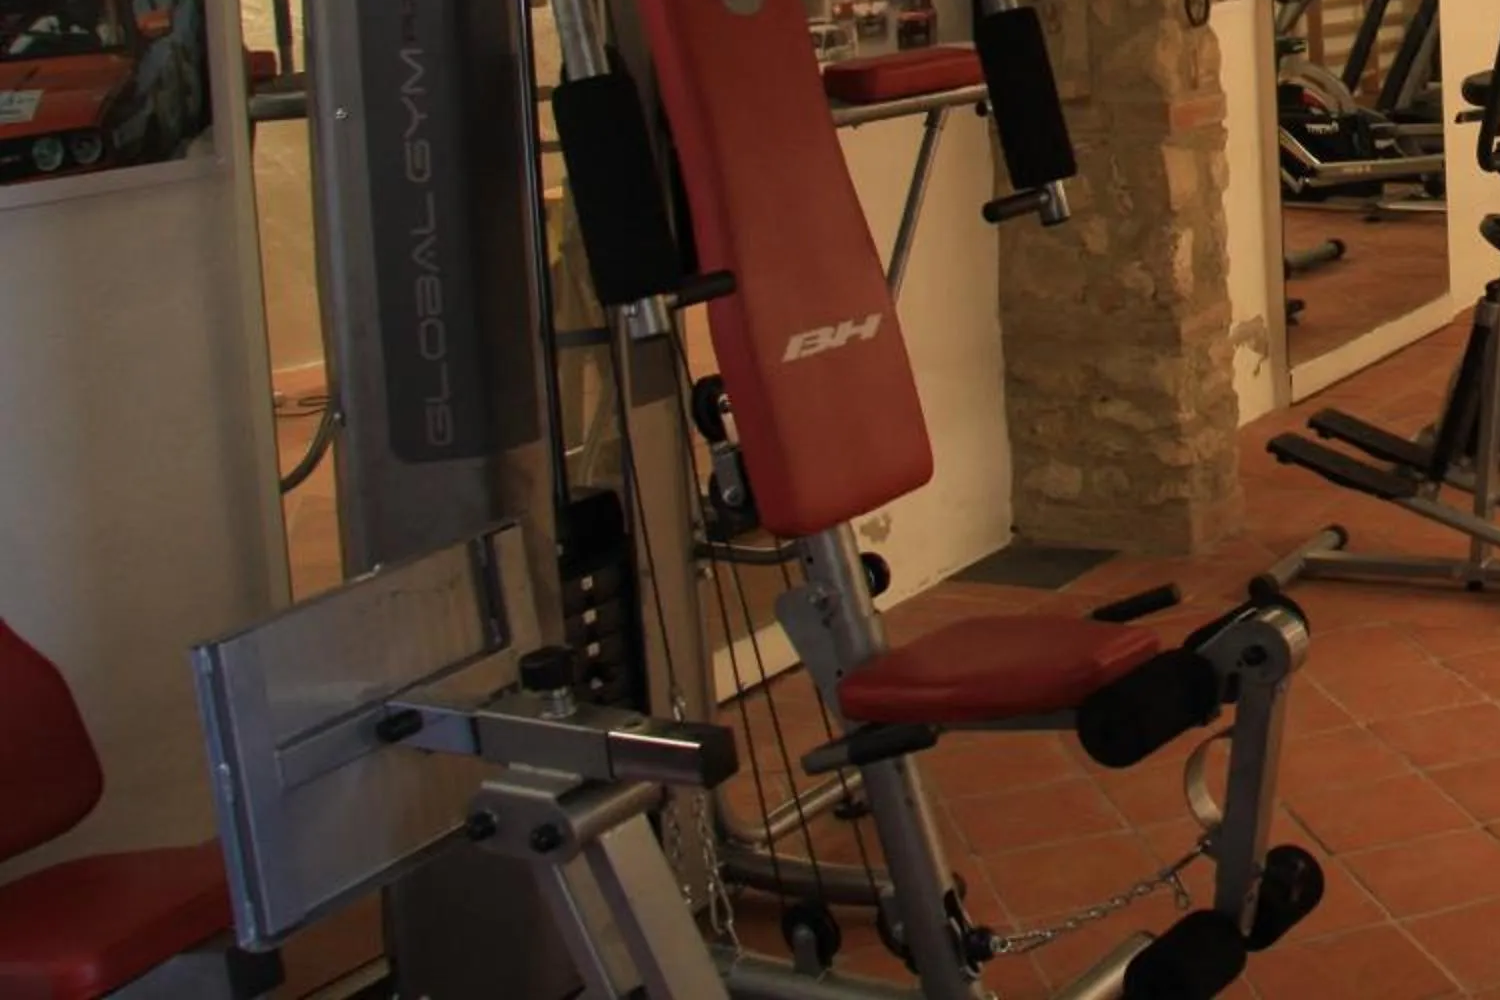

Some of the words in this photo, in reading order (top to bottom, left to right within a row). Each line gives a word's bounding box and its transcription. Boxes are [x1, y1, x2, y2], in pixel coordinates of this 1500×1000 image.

[399, 48, 432, 182] GYM
[409, 191, 454, 448] GLOBAL
[780, 312, 883, 364] BH
